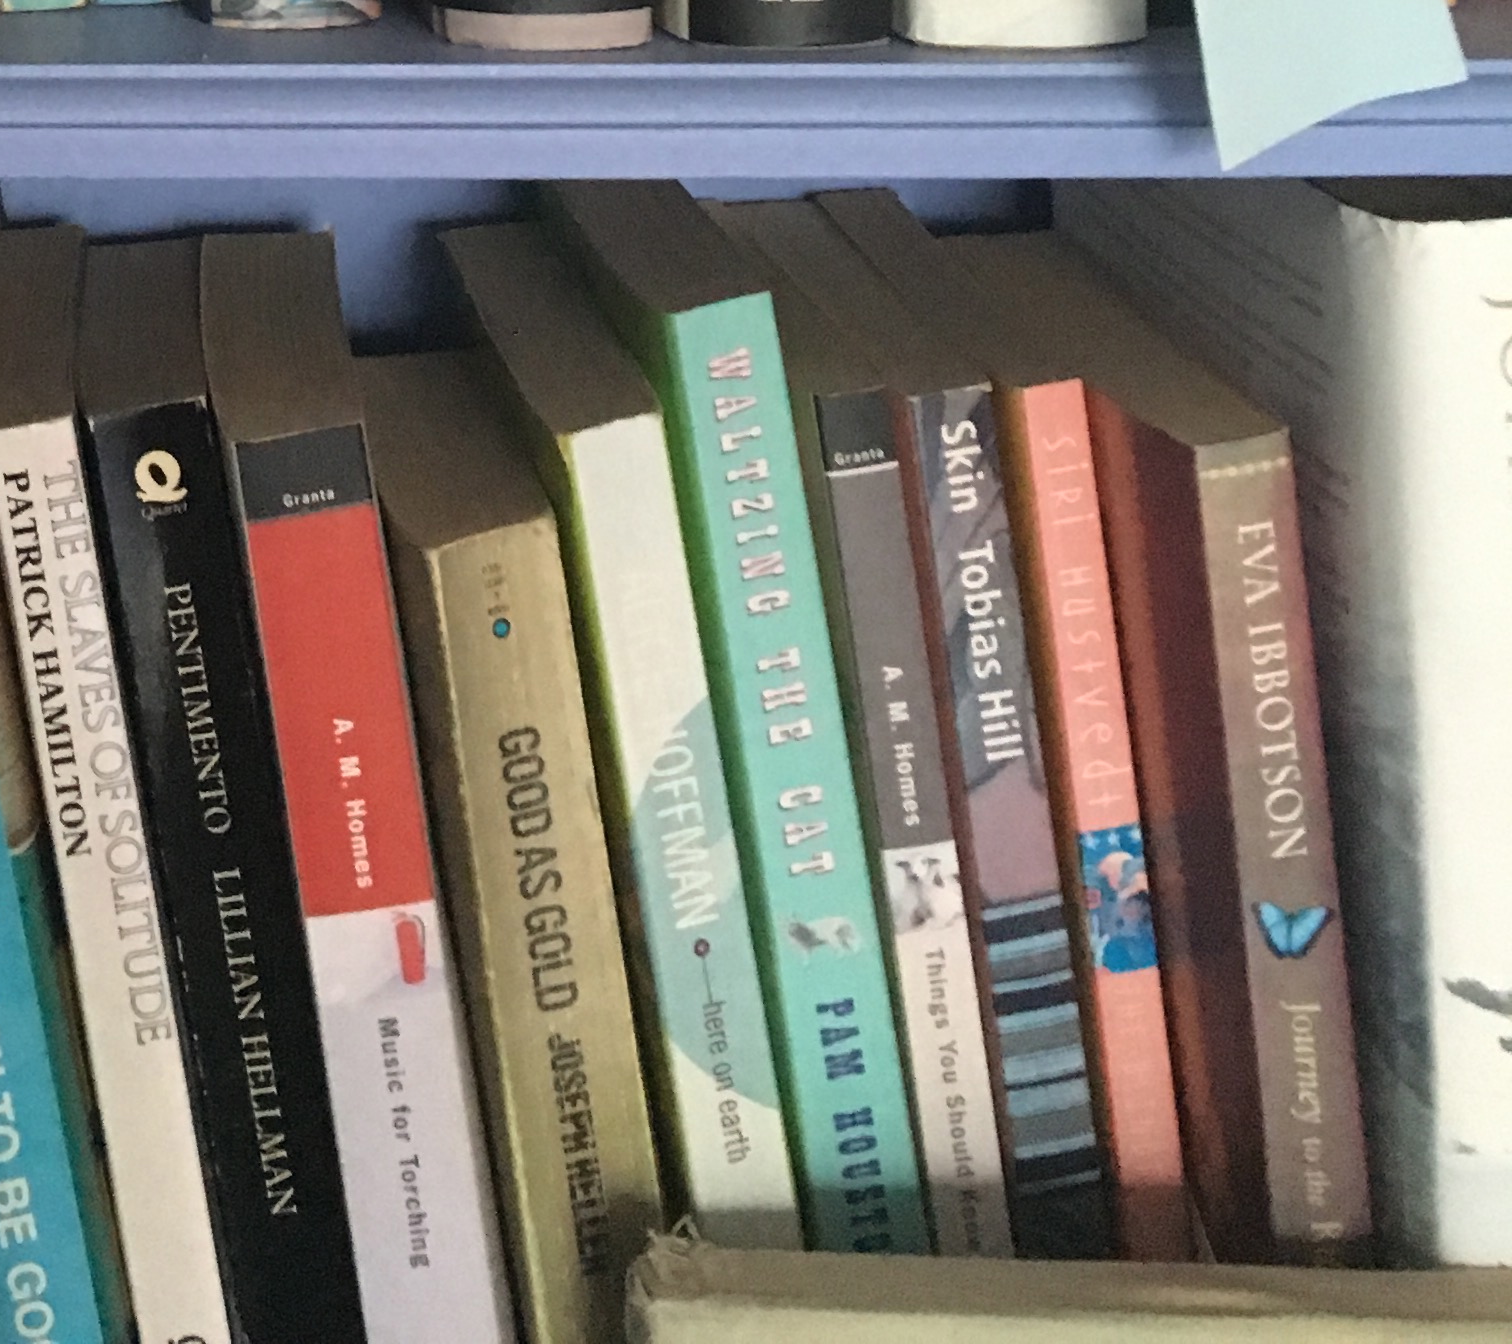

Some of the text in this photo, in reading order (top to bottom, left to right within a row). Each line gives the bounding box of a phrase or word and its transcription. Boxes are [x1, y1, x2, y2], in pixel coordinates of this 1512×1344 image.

[283, 493, 336, 509] Granta
[939, 419, 1026, 763] Skin Tobias Hill
[2, 468, 91, 860] PATRICK HAMILTON
[42, 462, 172, 1046] THE SLAVES OF SOLITUDE
[707, 346, 866, 1083] WALTZING THE CAT PAM
[894, 742, 924, 826] Homes
[162, 582, 298, 1218] PENTIMENTO LILLIAN HELLMAN
[331, 718, 376, 889] A. M. Homes
[497, 726, 580, 1013] GOOD AS GOLD
[1235, 520, 1333, 1208] EVA IBBOTSON Journey to the
[701, 1001, 752, 1164] here on earth
[924, 948, 952, 1030] Things
[936, 1038, 961, 1085] You
[376, 1016, 433, 1270] Music for Torching
[945, 1094, 975, 1179] Should
